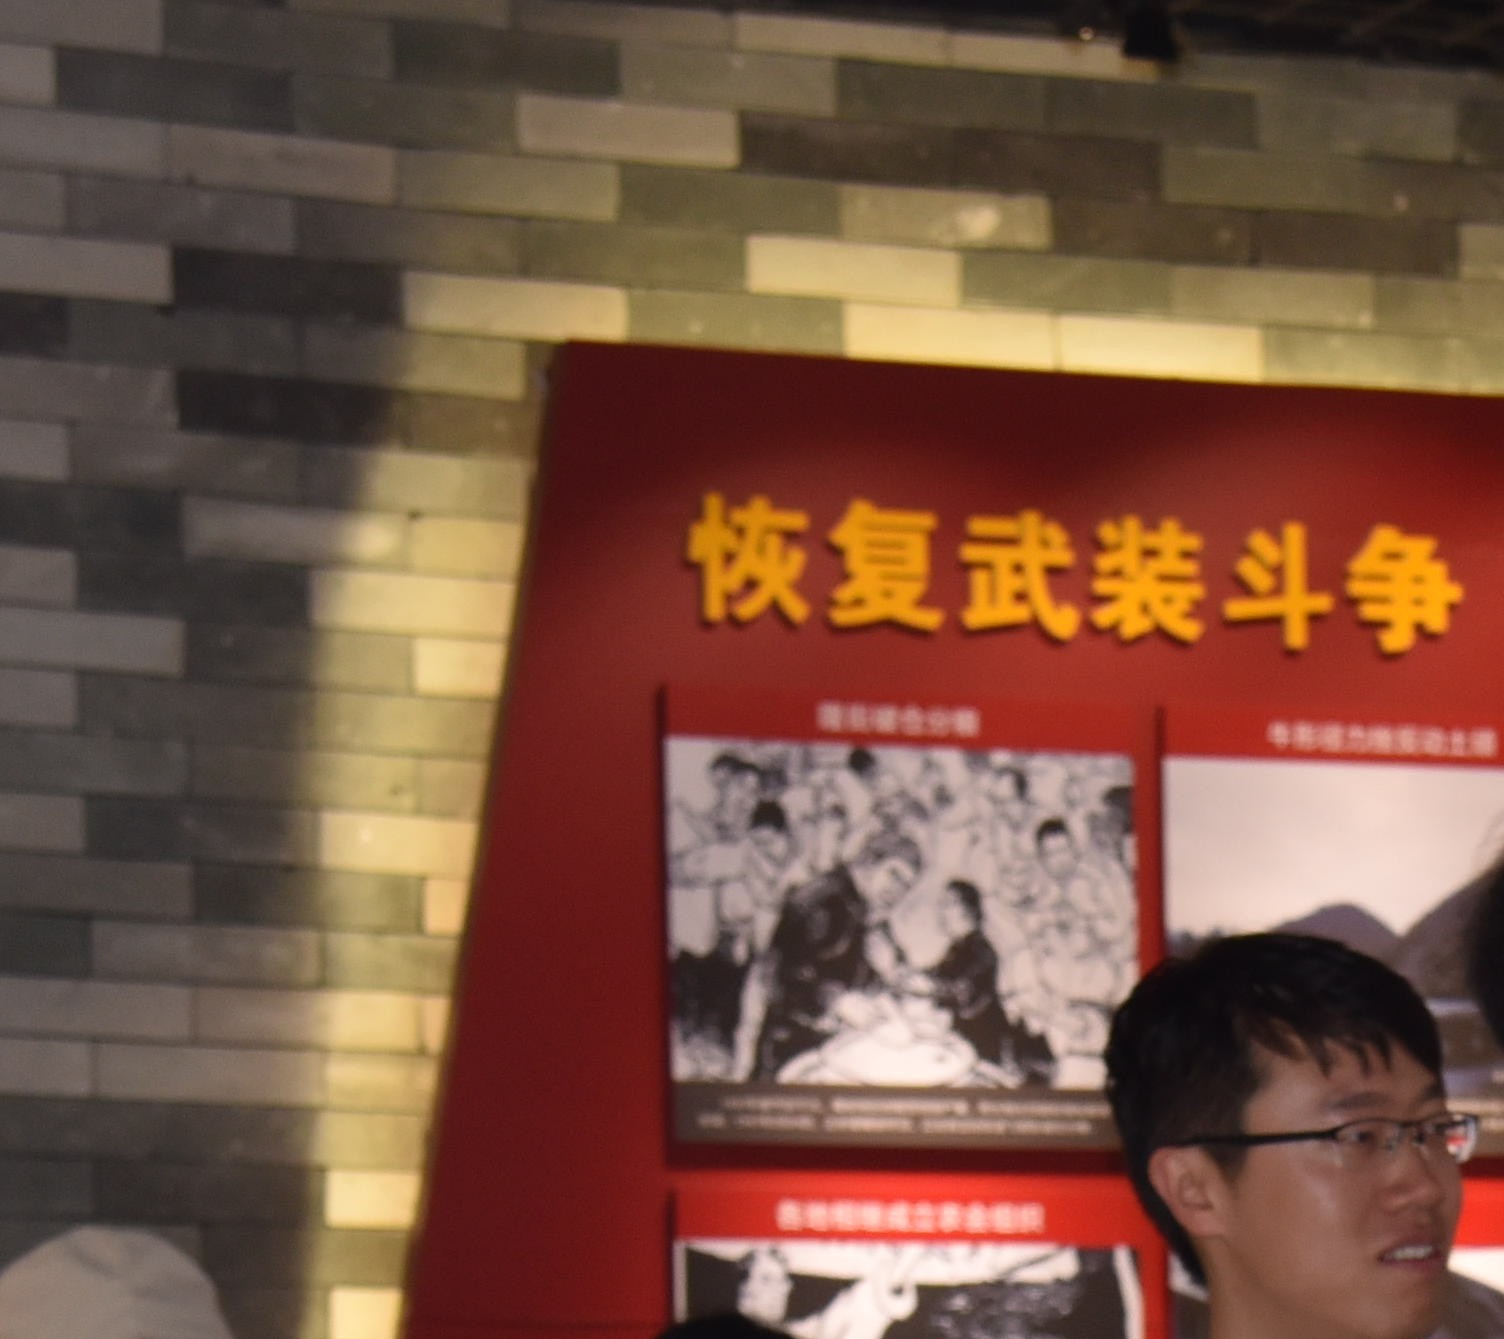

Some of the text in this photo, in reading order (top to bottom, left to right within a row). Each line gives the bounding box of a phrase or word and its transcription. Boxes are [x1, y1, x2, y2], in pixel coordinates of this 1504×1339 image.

[686, 492, 1464, 656] 恢复武装斗争
